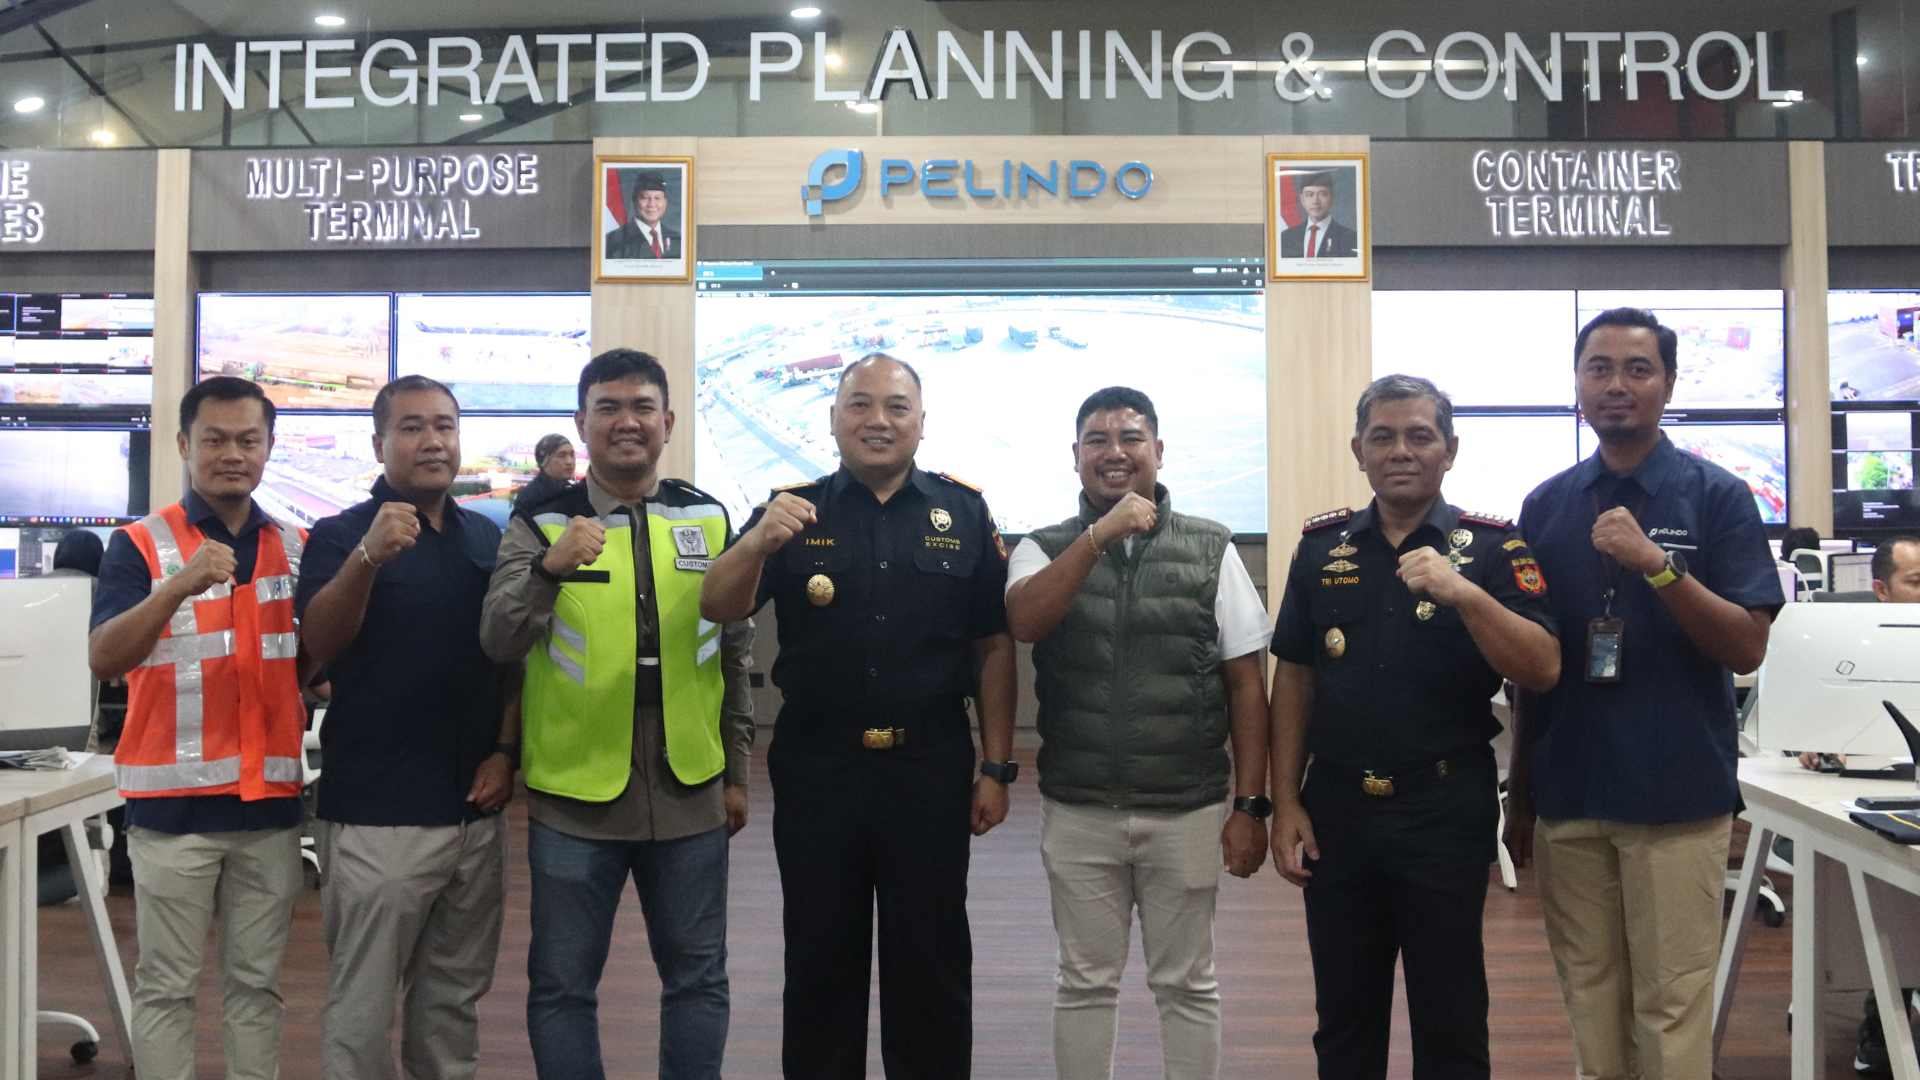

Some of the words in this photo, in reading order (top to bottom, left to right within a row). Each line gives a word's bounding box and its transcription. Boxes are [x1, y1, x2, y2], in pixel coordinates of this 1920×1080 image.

[175, 32, 709, 111] INTEGRATED
[749, 30, 1234, 101] PLANNING
[1275, 32, 1332, 101] &
[1366, 30, 1803, 102] CONTROL
[246, 154, 539, 199] MULTI-PURPOSE
[881, 159, 1154, 199] PELINDO
[1472, 149, 1681, 193] CONTAINER
[303, 200, 480, 242] TERMINAL
[1486, 194, 1671, 237] TERMINAL
[805, 537, 835, 547] IMIK
[678, 560, 711, 569] CUSTOM
